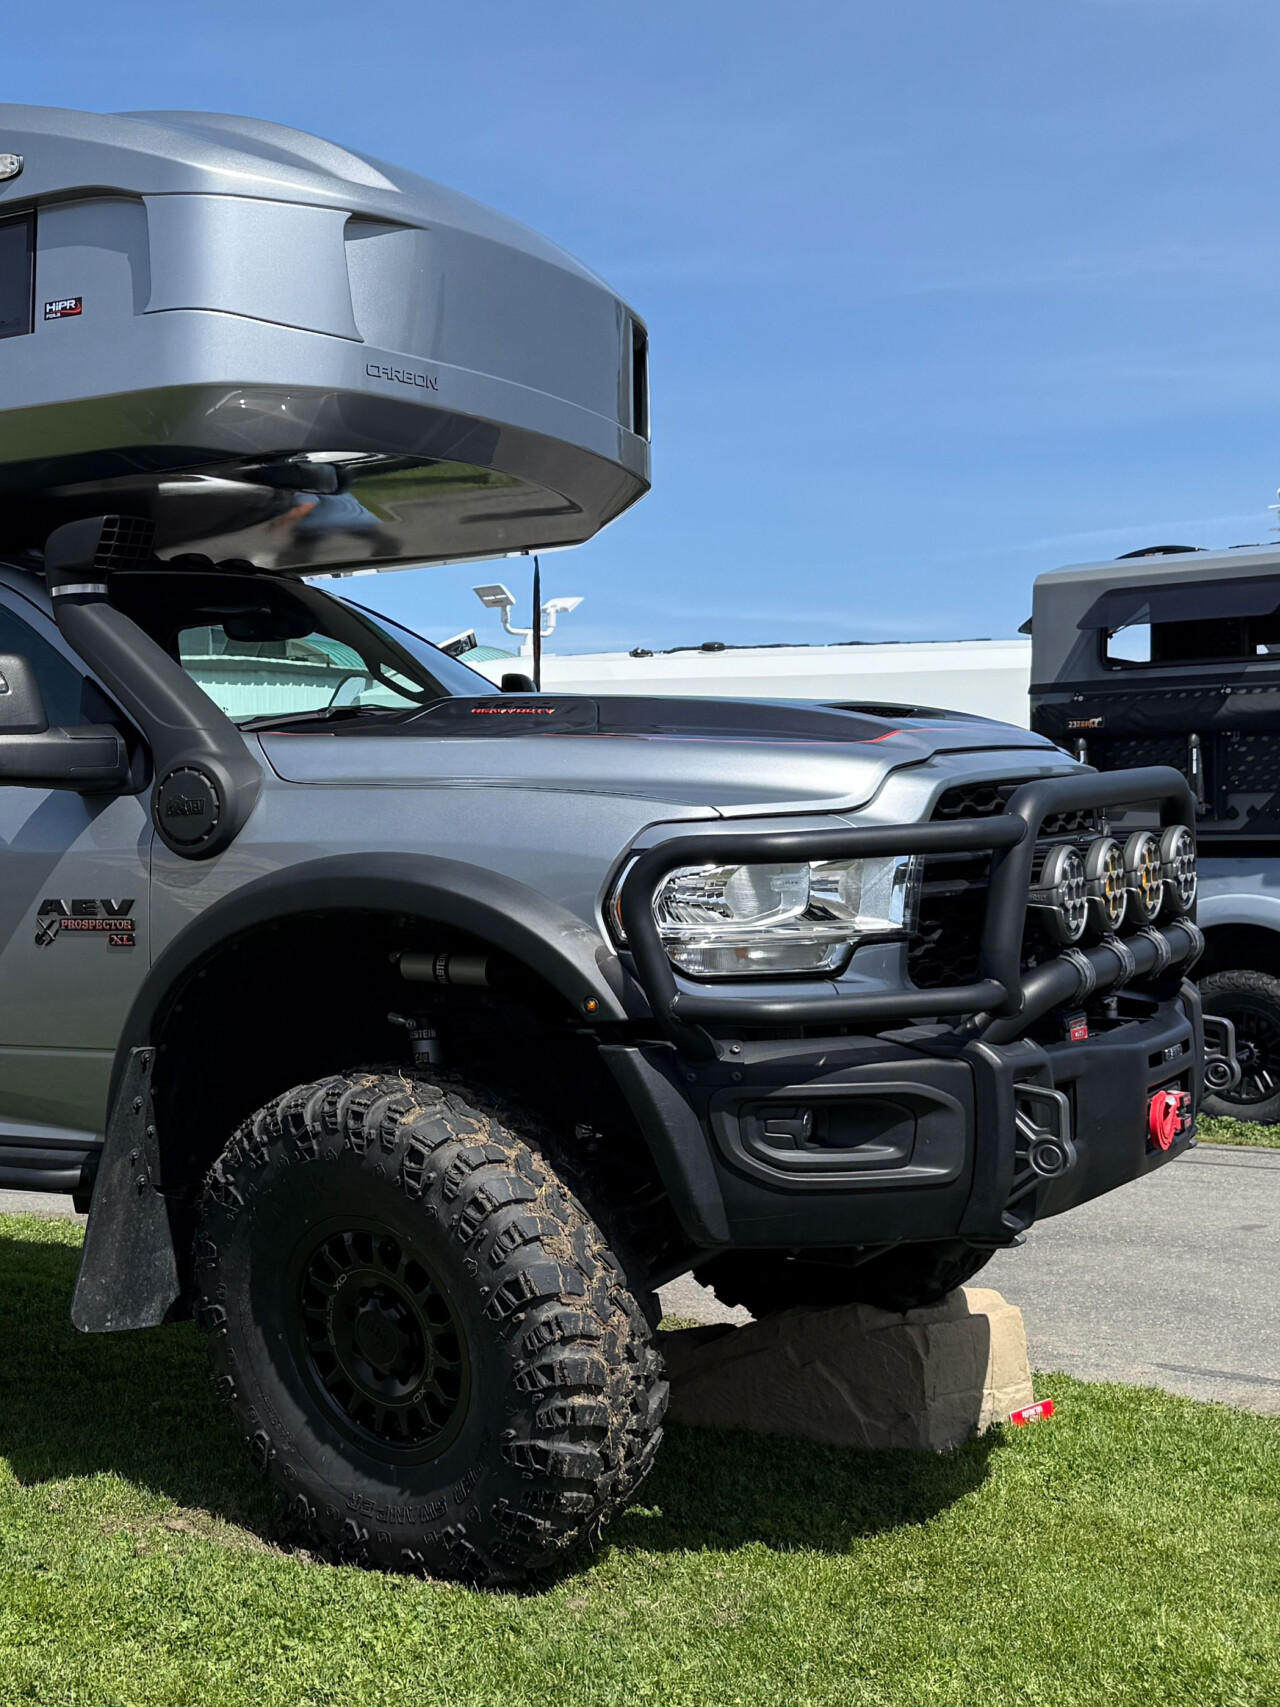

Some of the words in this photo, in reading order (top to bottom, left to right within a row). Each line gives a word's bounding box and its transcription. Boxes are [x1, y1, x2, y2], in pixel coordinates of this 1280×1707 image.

[37, 899, 136, 916] AEV
[61, 919, 132, 930] PROSPECTOR
[111, 935, 133, 945] XL
